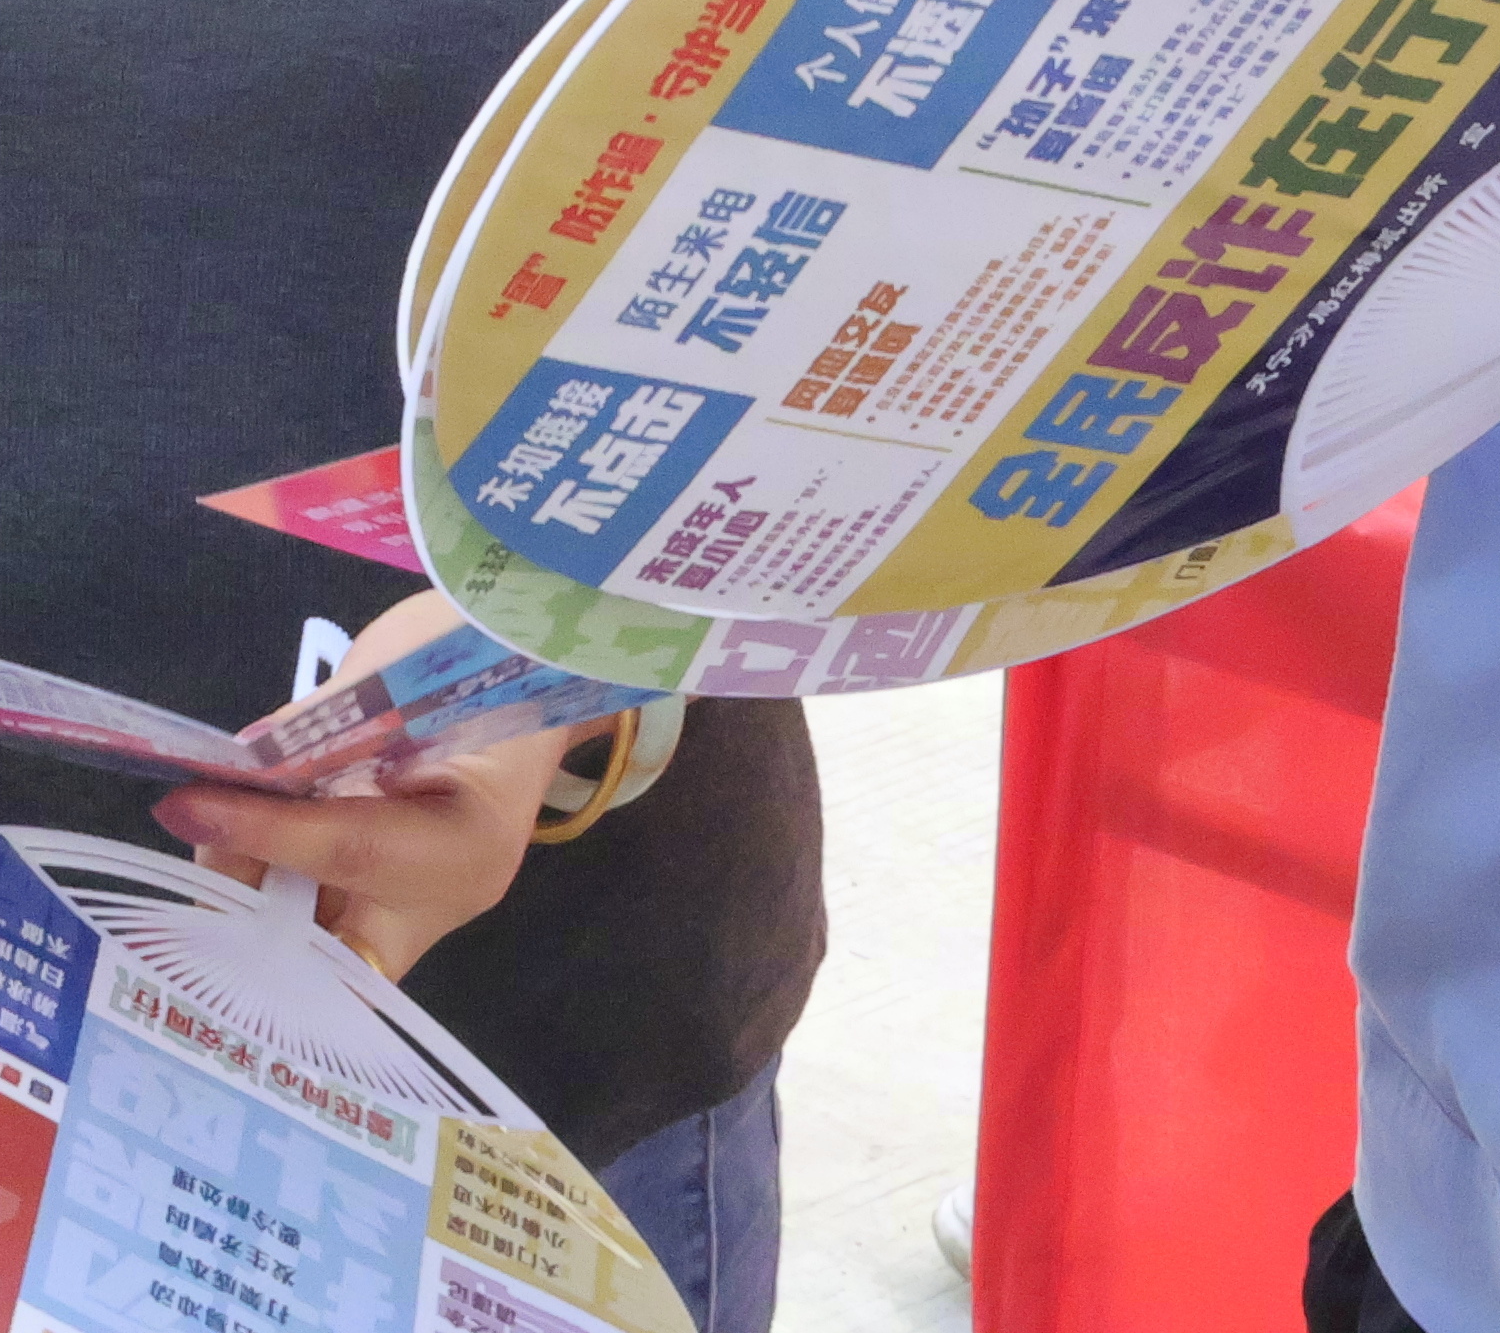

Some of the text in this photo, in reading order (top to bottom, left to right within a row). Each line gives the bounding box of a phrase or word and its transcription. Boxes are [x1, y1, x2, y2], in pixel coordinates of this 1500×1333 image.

[1023, 52, 1137, 164] 要警惕
[614, 186, 760, 331] 陌生来电
[673, 189, 850, 354] 不轻信
[1244, 120, 1499, 397] 天宁分局红梅派出所 宣
[780, 279, 910, 411] 网恋交友
[818, 320, 923, 417] 要谨慎
[471, 376, 617, 512] 未知链接
[529, 379, 708, 535] 不点击
[634, 475, 758, 584] 未成年人
[670, 506, 770, 590] 要小心
[131, 987, 397, 1142] 警民同心 平安同行
[163, 1202, 298, 1287] 发生矛盾时
[170, 1165, 304, 1250] 要冷静处理
[154, 1240, 292, 1326] 打架成本高
